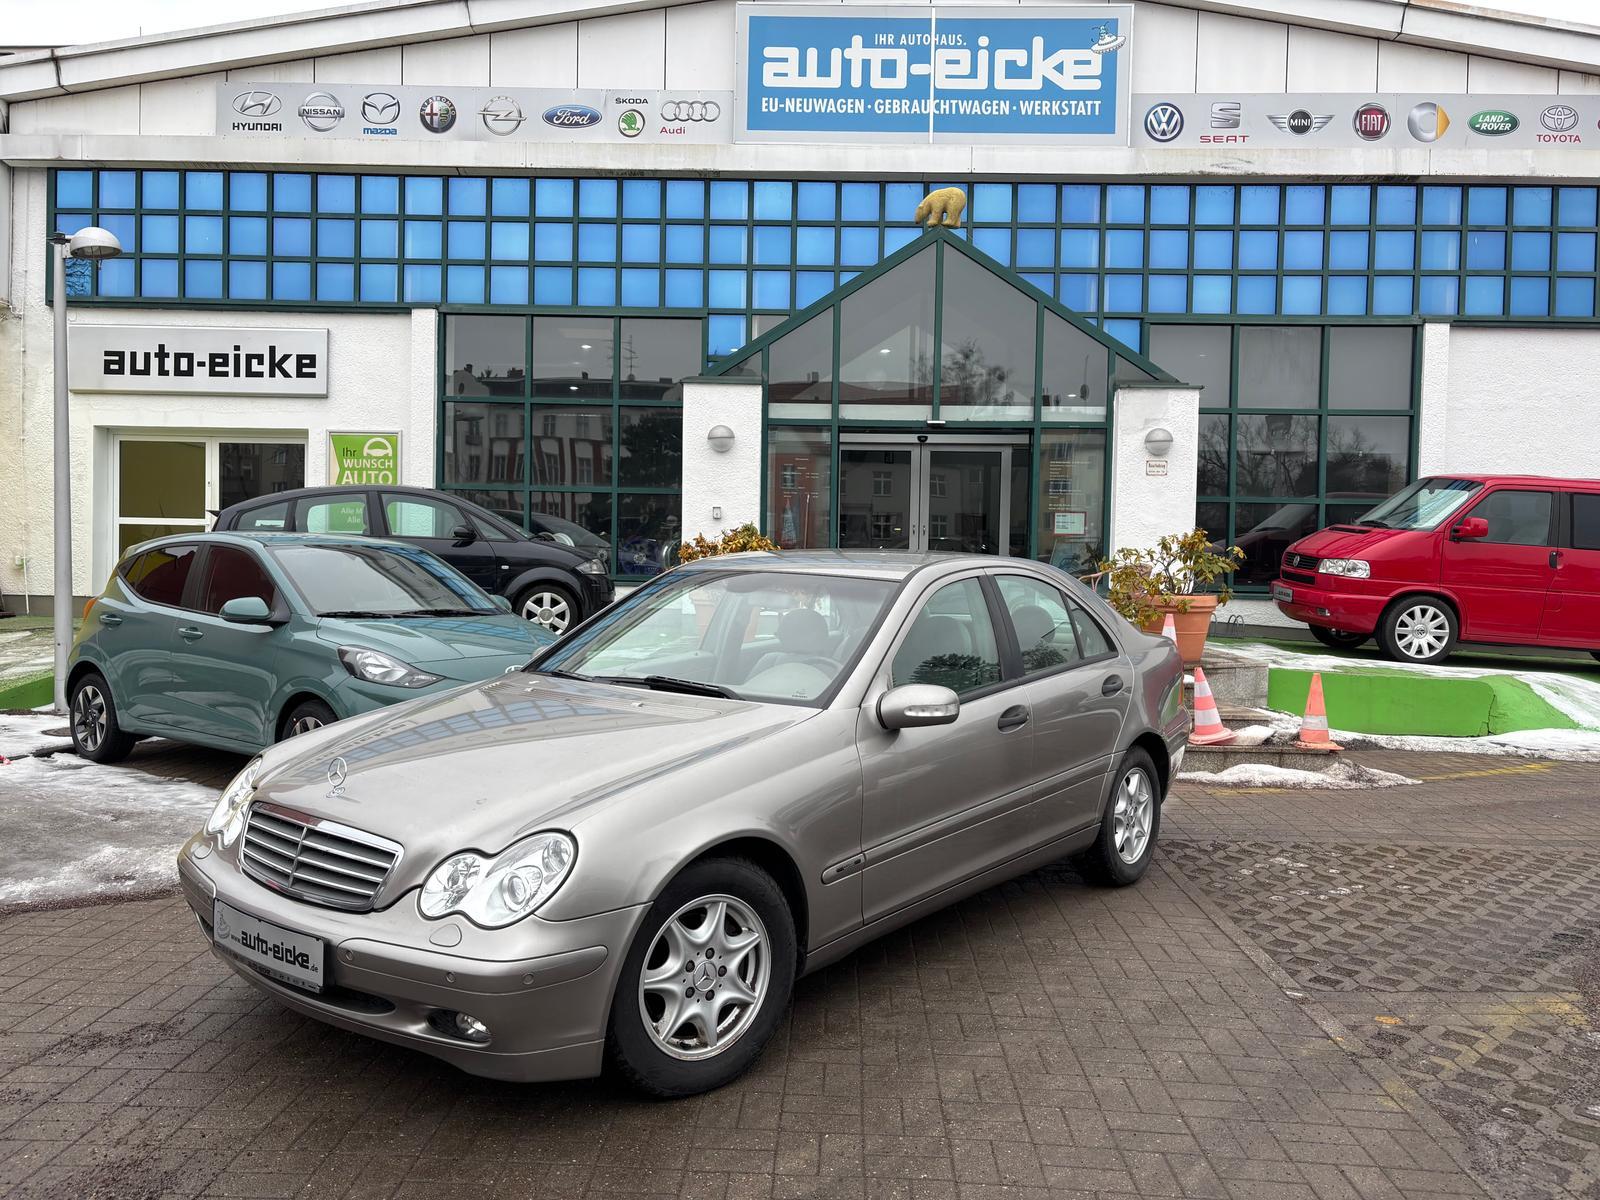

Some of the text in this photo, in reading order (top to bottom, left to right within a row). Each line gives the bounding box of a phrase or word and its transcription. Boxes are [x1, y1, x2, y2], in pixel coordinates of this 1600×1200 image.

[875, 34, 894, 45] IHR
[763, 35, 1102, 90] auto-eicke
[762, 98, 1102, 116] EU-NEUWAGEN GEBRAUCHTWAGEN WERKSTATT
[302, 108, 341, 117] NISSAN
[553, 108, 591, 125] Ford
[232, 122, 282, 131] HYUNDAI
[1289, 118, 1311, 127] MINI
[1362, 114, 1383, 131] FIAT
[660, 126, 686, 135] Audi
[1200, 135, 1249, 143] SEAT
[1536, 134, 1581, 143] TOYOTA
[103, 343, 316, 379] auto-eicke
[342, 447, 357, 457] Ihr
[343, 459, 393, 468] WUNSCH
[341, 470, 393, 485] AUTO
